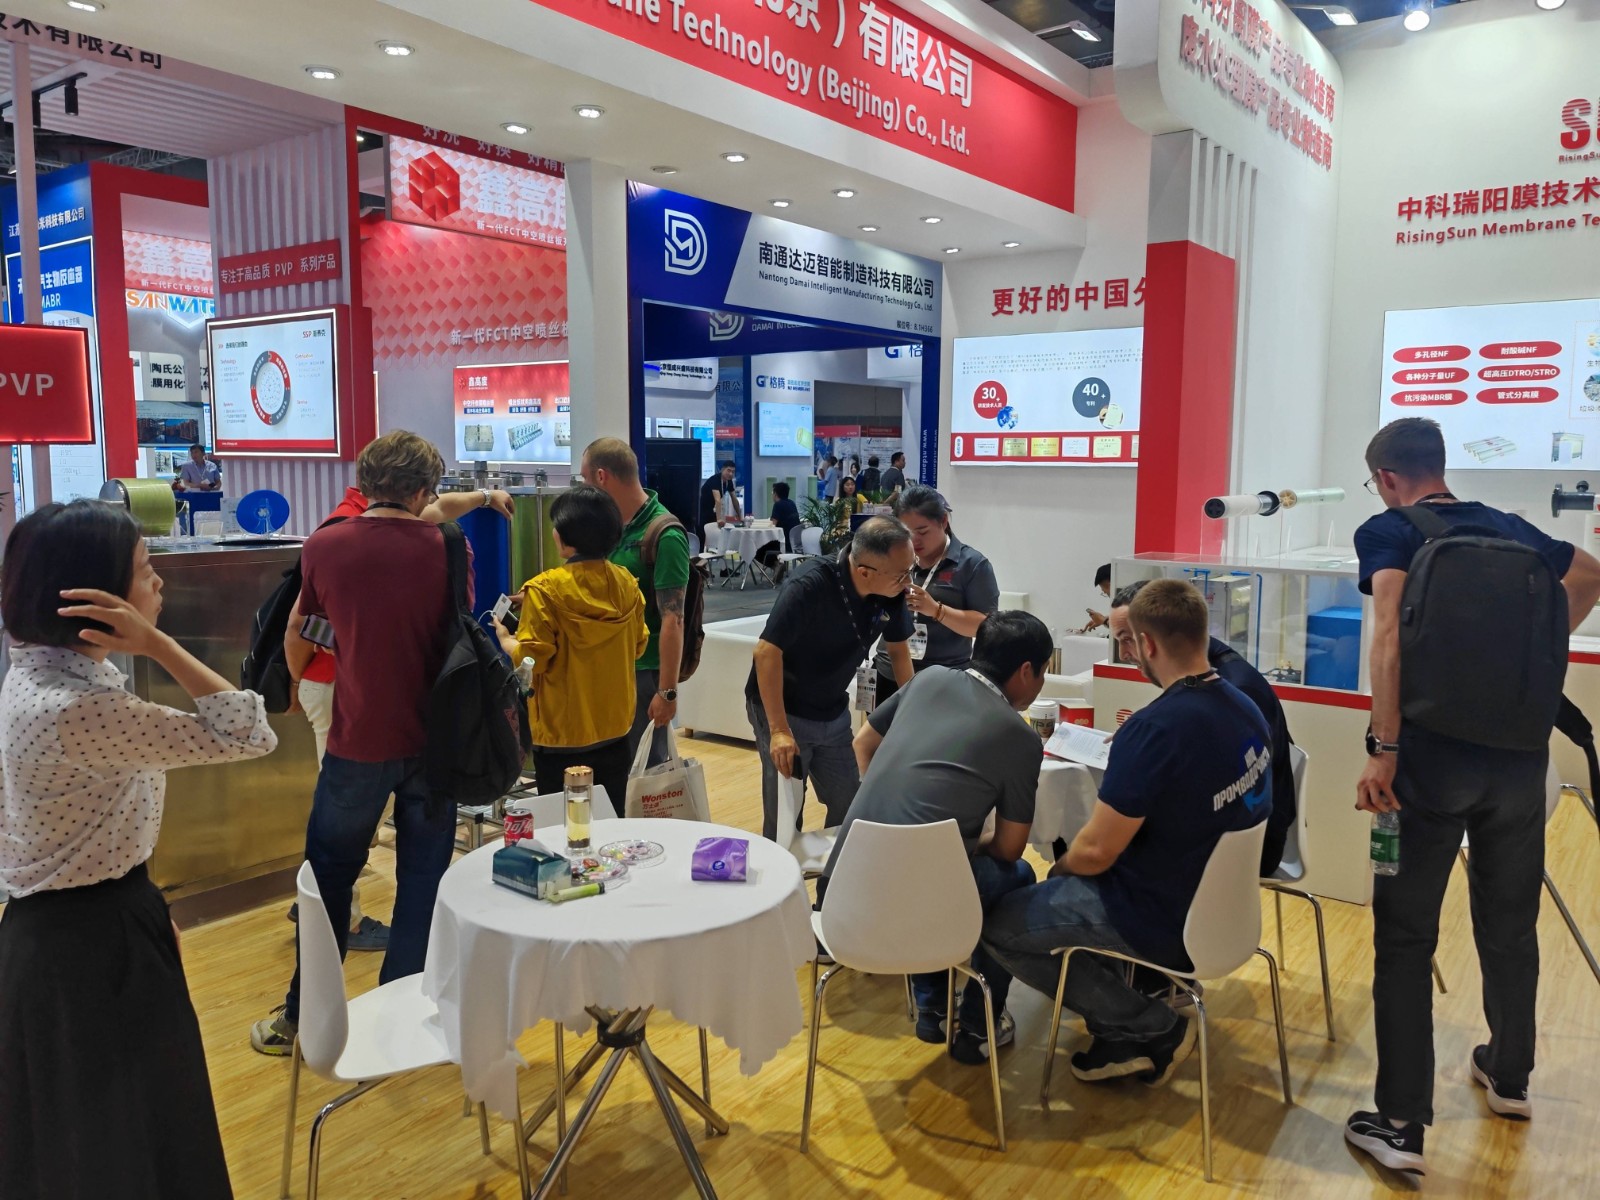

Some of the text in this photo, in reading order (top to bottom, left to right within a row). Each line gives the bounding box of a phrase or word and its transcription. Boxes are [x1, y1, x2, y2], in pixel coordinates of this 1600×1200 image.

[669, 0, 813, 95] Technology
[818, 64, 901, 131] (Beijing)
[905, 104, 937, 146] Co.,
[941, 118, 970, 156] Ltd.
[1395, 227, 1477, 245] RisingSun
[1482, 217, 1577, 238] Membrane
[220, 253, 337, 284] 专注于高品质 PVP 系列产品
[758, 240, 935, 299] 南通达迈智能制造科技有限公司
[758, 270, 788, 287] Nantong
[789, 276, 811, 289] Damai
[810, 280, 842, 295] Intelligent
[843, 286, 884, 305] Manufacturing
[884, 294, 914, 310] Technology
[641, 788, 683, 804] Wonston
